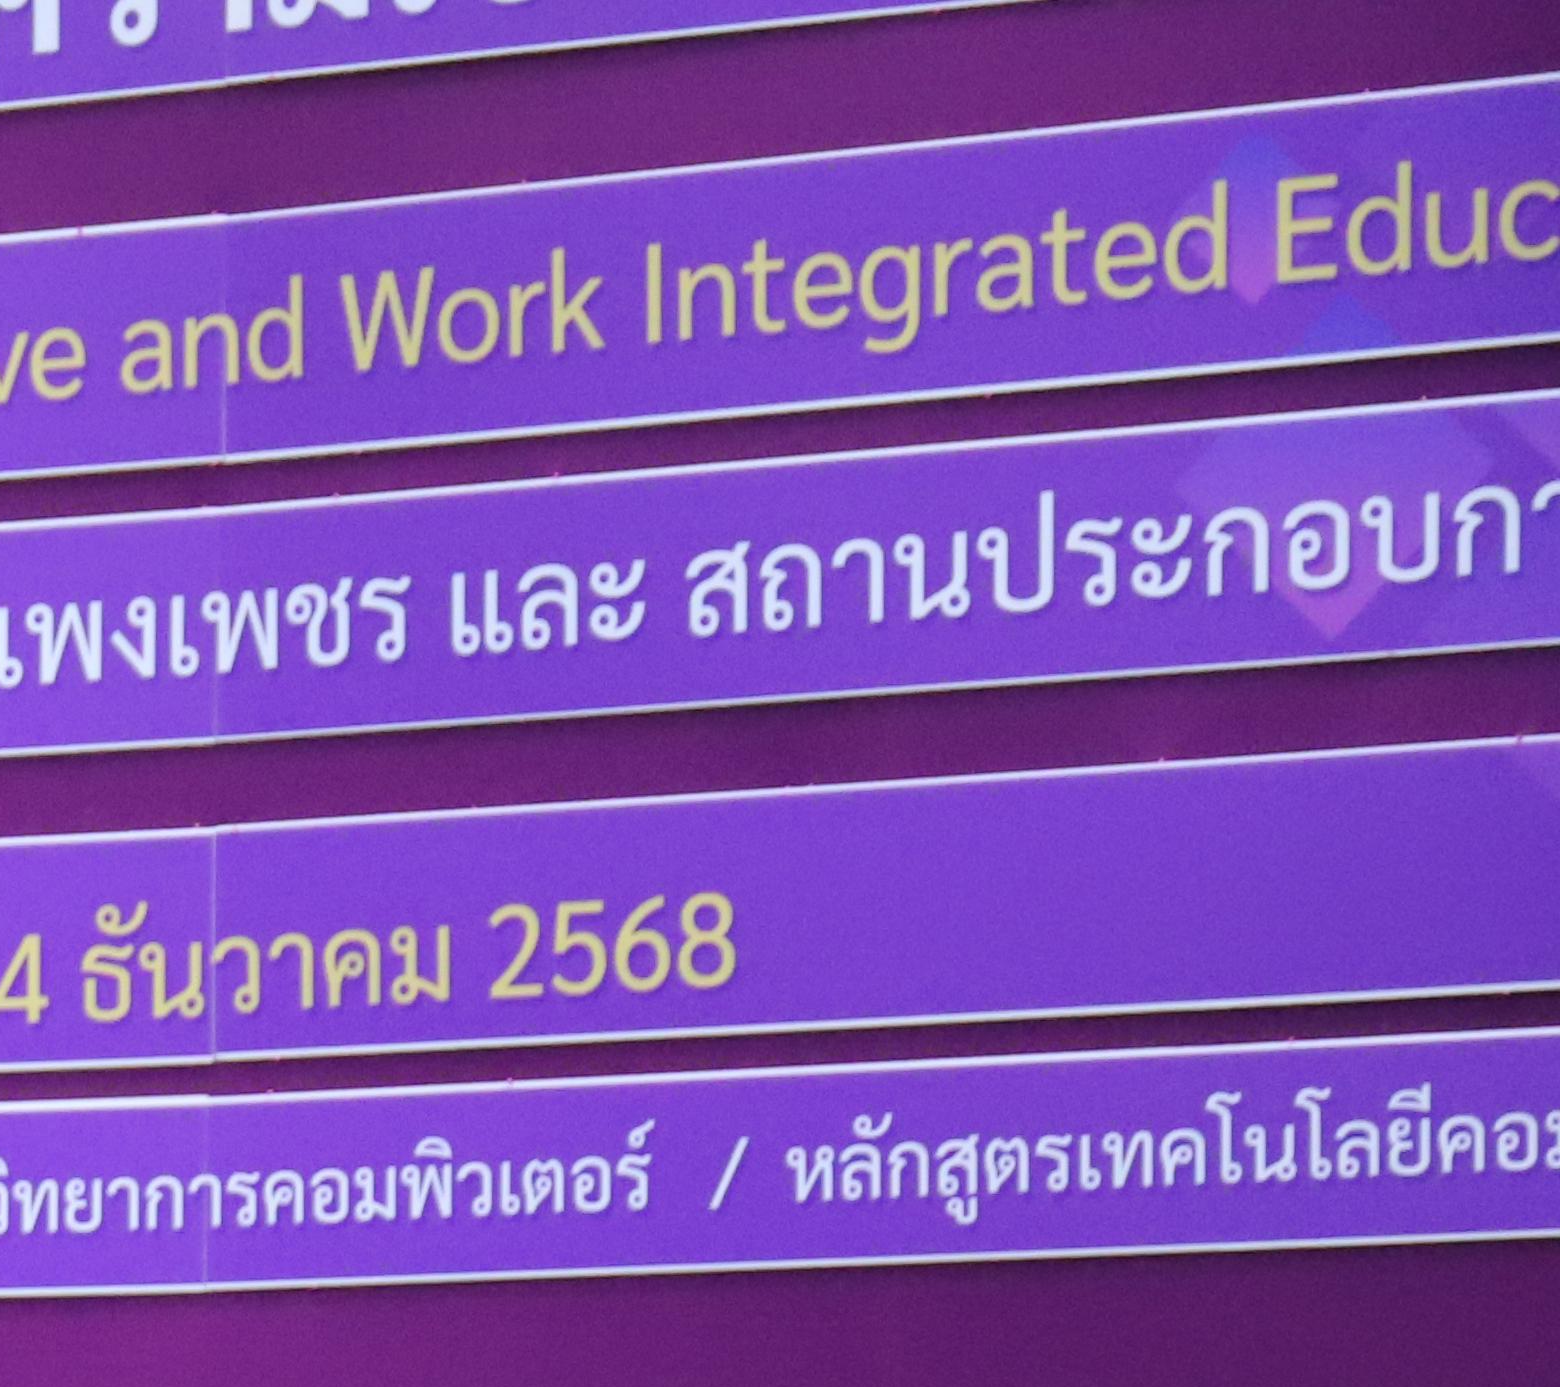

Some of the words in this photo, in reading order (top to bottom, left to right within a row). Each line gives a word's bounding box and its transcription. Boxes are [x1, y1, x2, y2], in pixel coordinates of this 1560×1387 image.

[119, 273, 304, 394] and
[339, 246, 606, 372] Work
[644, 181, 1229, 352] Integrated
[450, 558, 647, 657] และ
[80, 900, 451, 1023] ธันวาคม
[488, 891, 737, 1000] 2568
